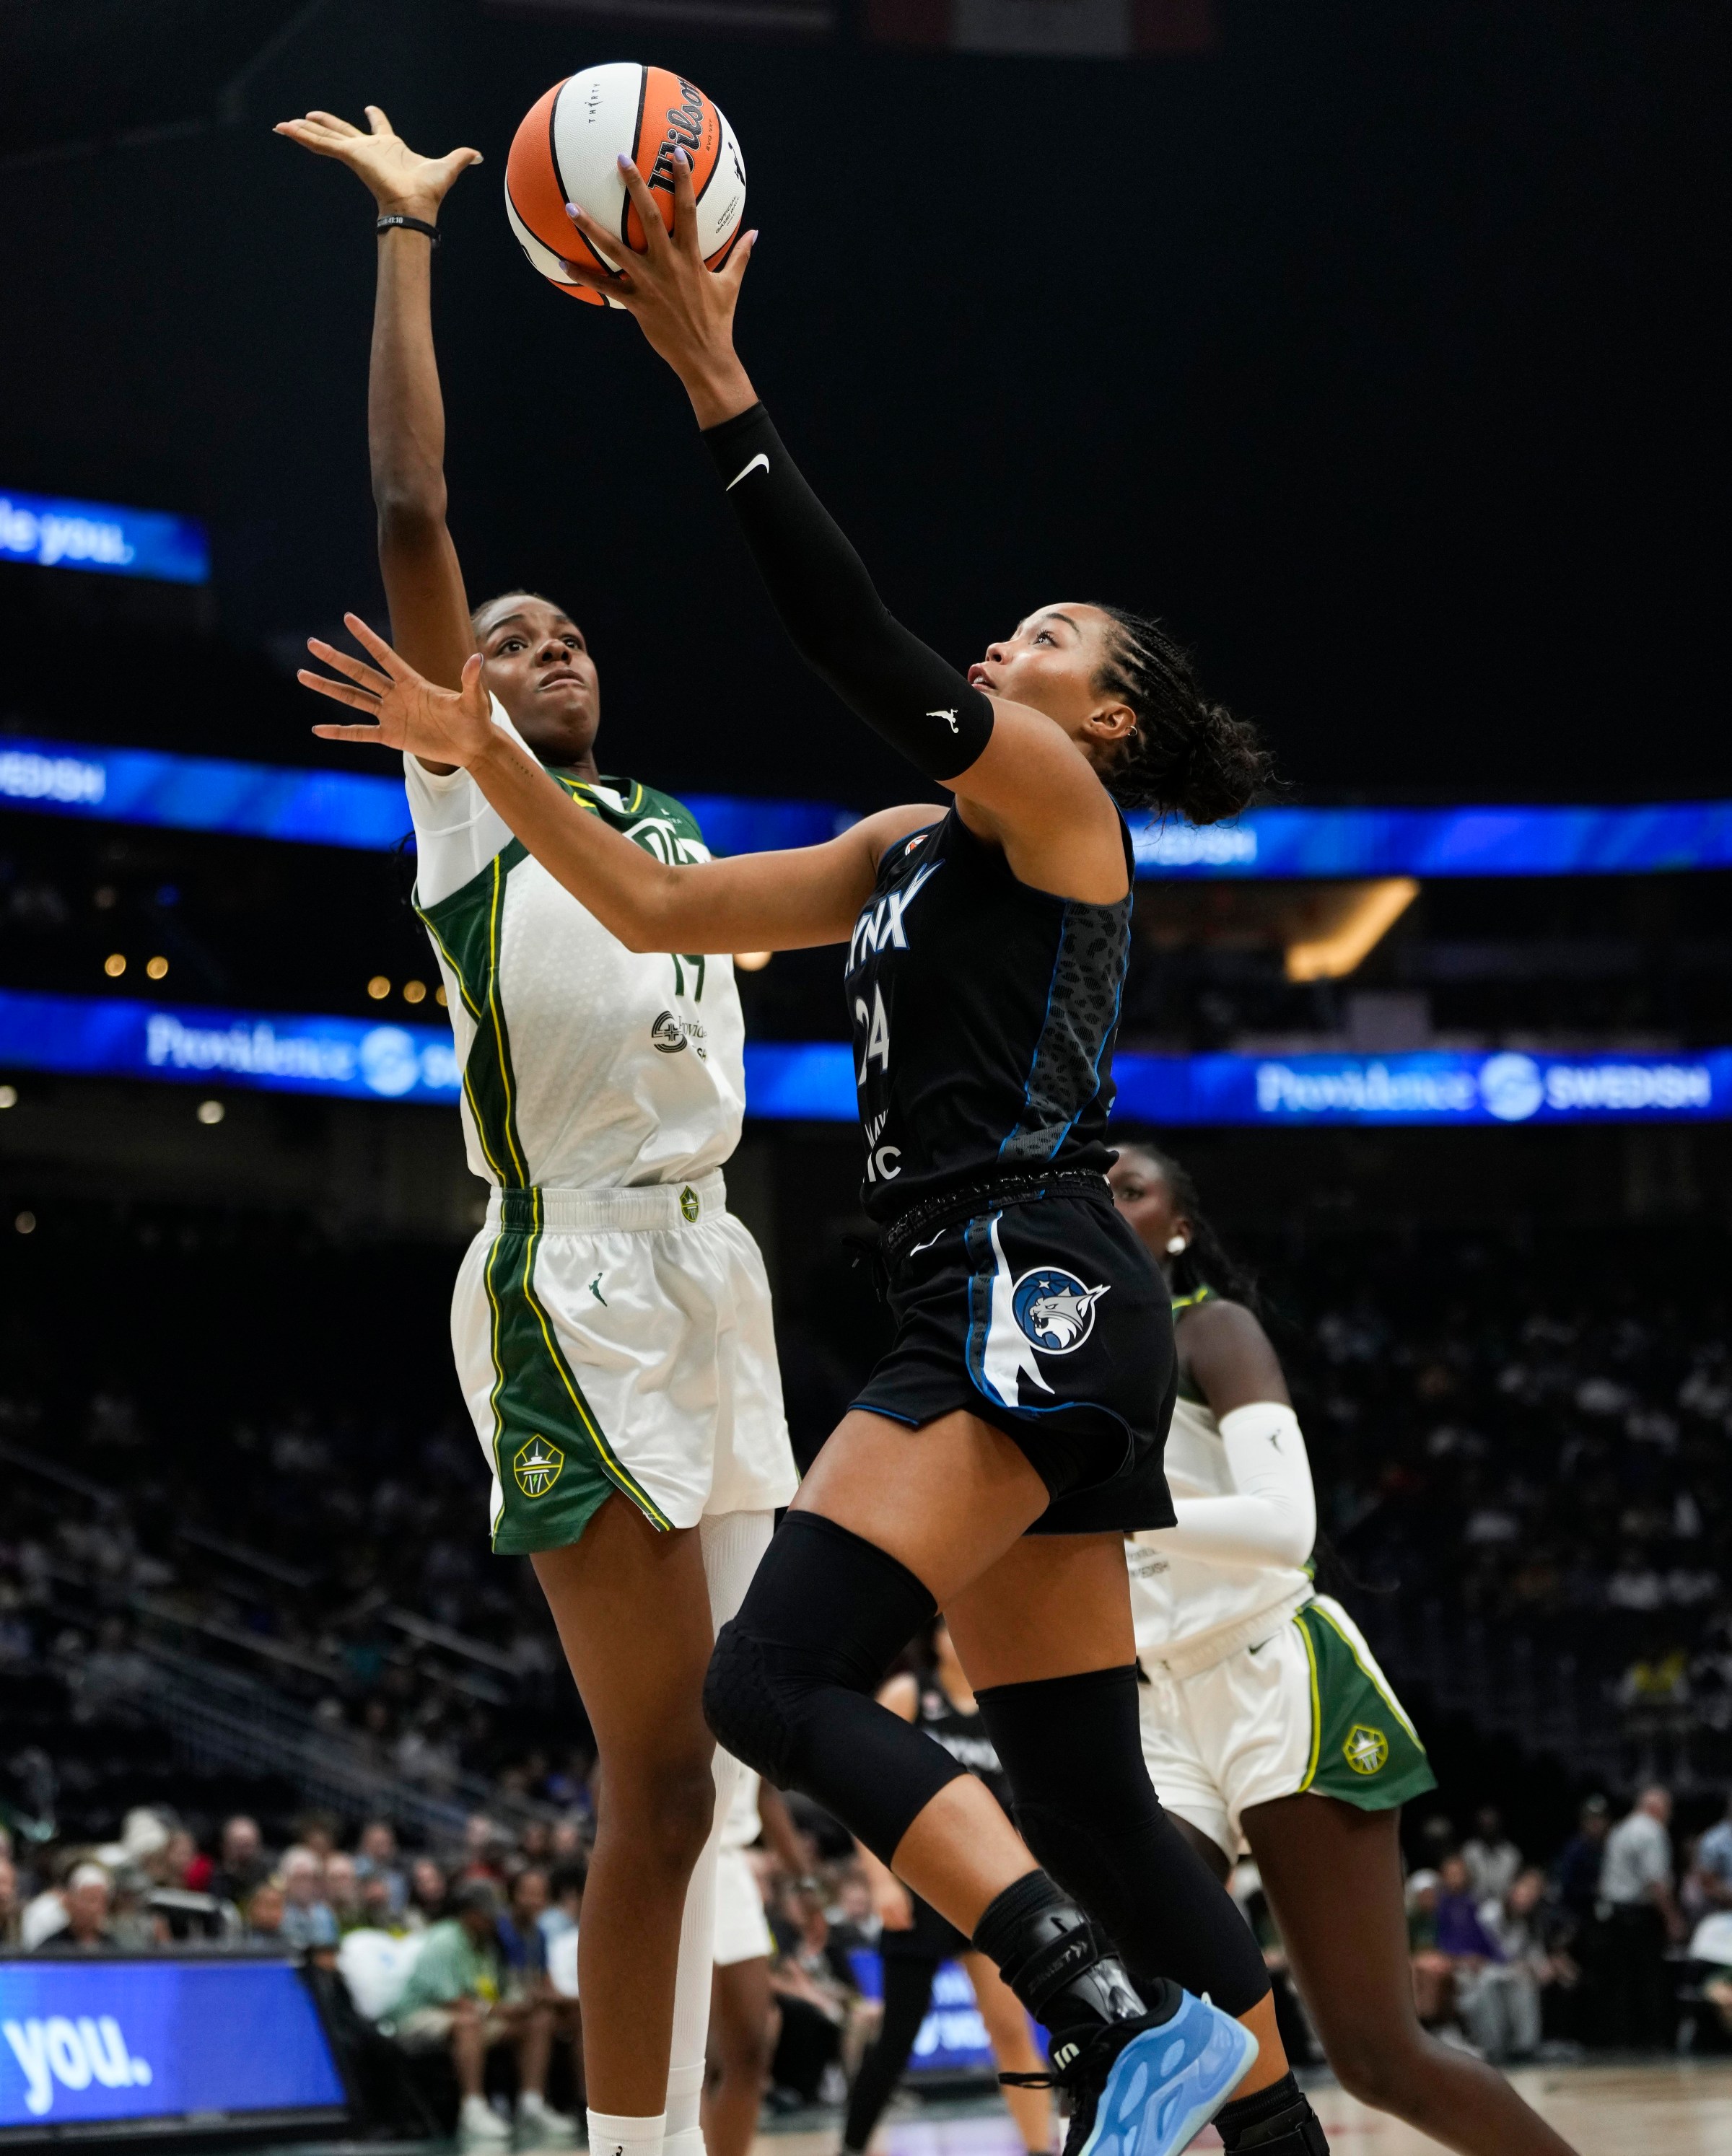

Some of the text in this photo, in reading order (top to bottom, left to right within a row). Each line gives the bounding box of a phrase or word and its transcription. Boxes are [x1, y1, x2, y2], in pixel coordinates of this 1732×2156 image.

[647, 75, 704, 196] Wilson
[844, 858, 947, 981] YNX
[854, 979, 891, 1088] 24
[1544, 1064, 1711, 1110] SWEDISH
[2, 2014, 153, 2116] you.
